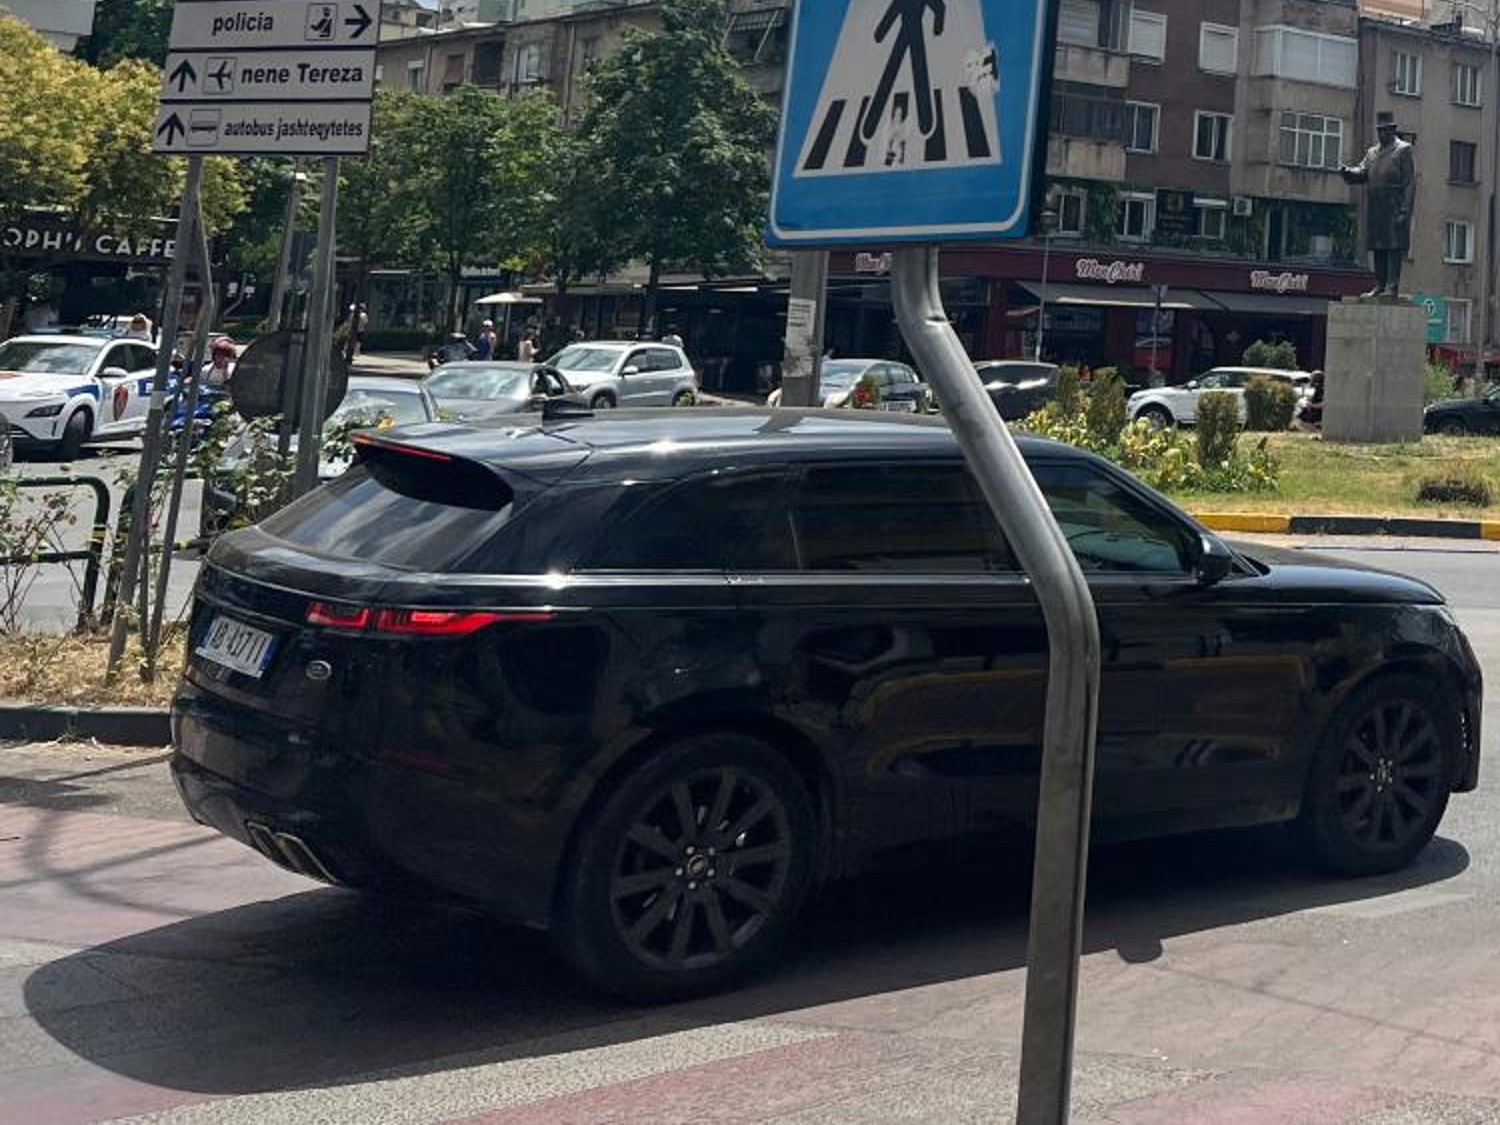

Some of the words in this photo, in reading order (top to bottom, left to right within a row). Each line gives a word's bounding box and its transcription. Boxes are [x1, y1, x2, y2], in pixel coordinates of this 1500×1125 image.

[211, 12, 274, 36] policia
[240, 66, 290, 84] nene
[297, 62, 363, 84] Tereza
[223, 118, 273, 136] autobus
